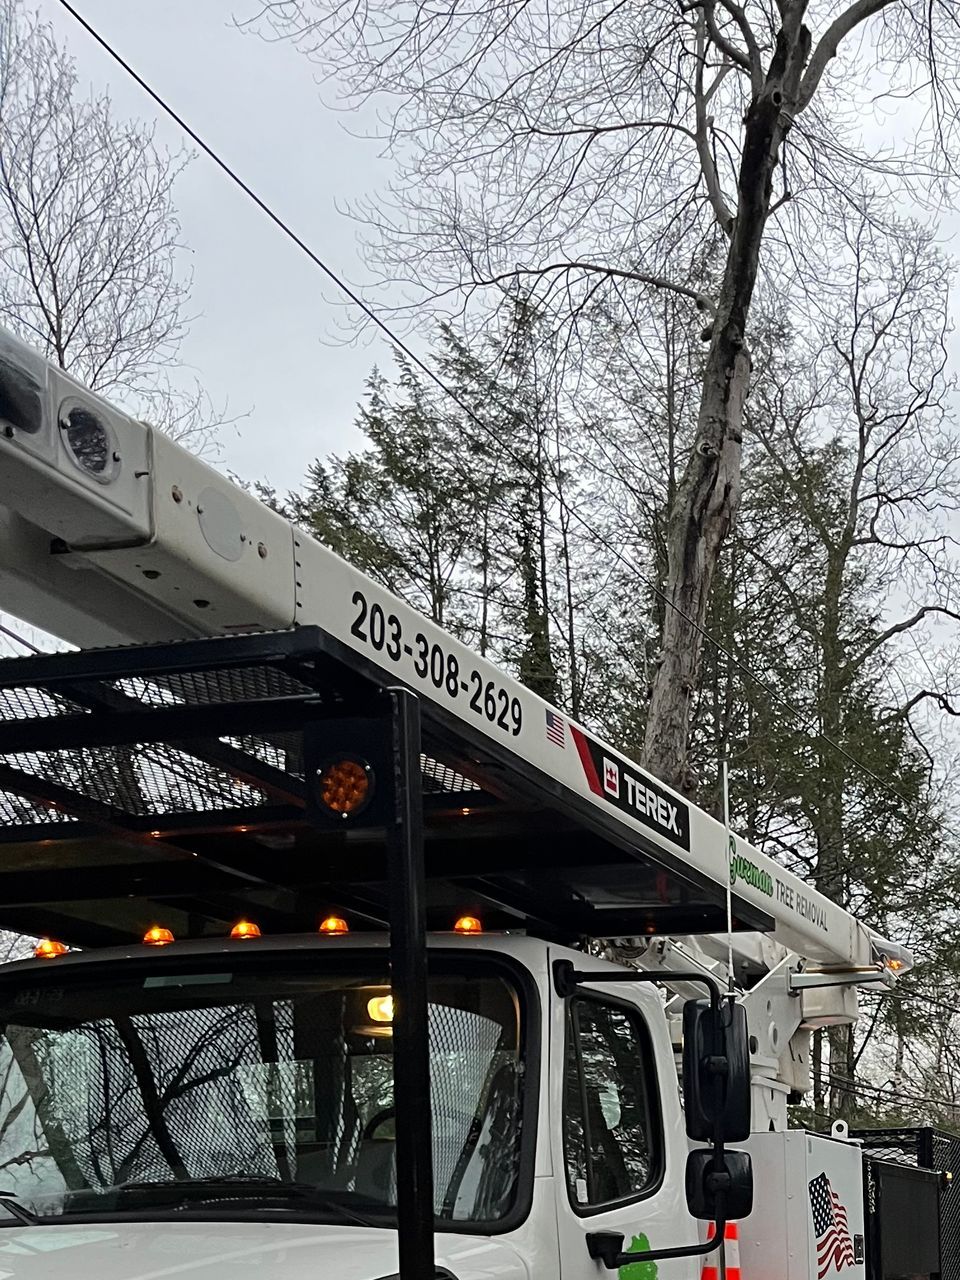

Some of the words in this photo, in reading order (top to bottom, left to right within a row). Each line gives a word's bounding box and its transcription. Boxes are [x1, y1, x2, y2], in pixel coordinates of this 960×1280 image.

[351, 591, 522, 736] 203-308-2629
[623, 772, 679, 836] TEREX
[725, 835, 774, 898] Guzman
[775, 878, 794, 910] TREE
[796, 893, 828, 932] REMOVAL
